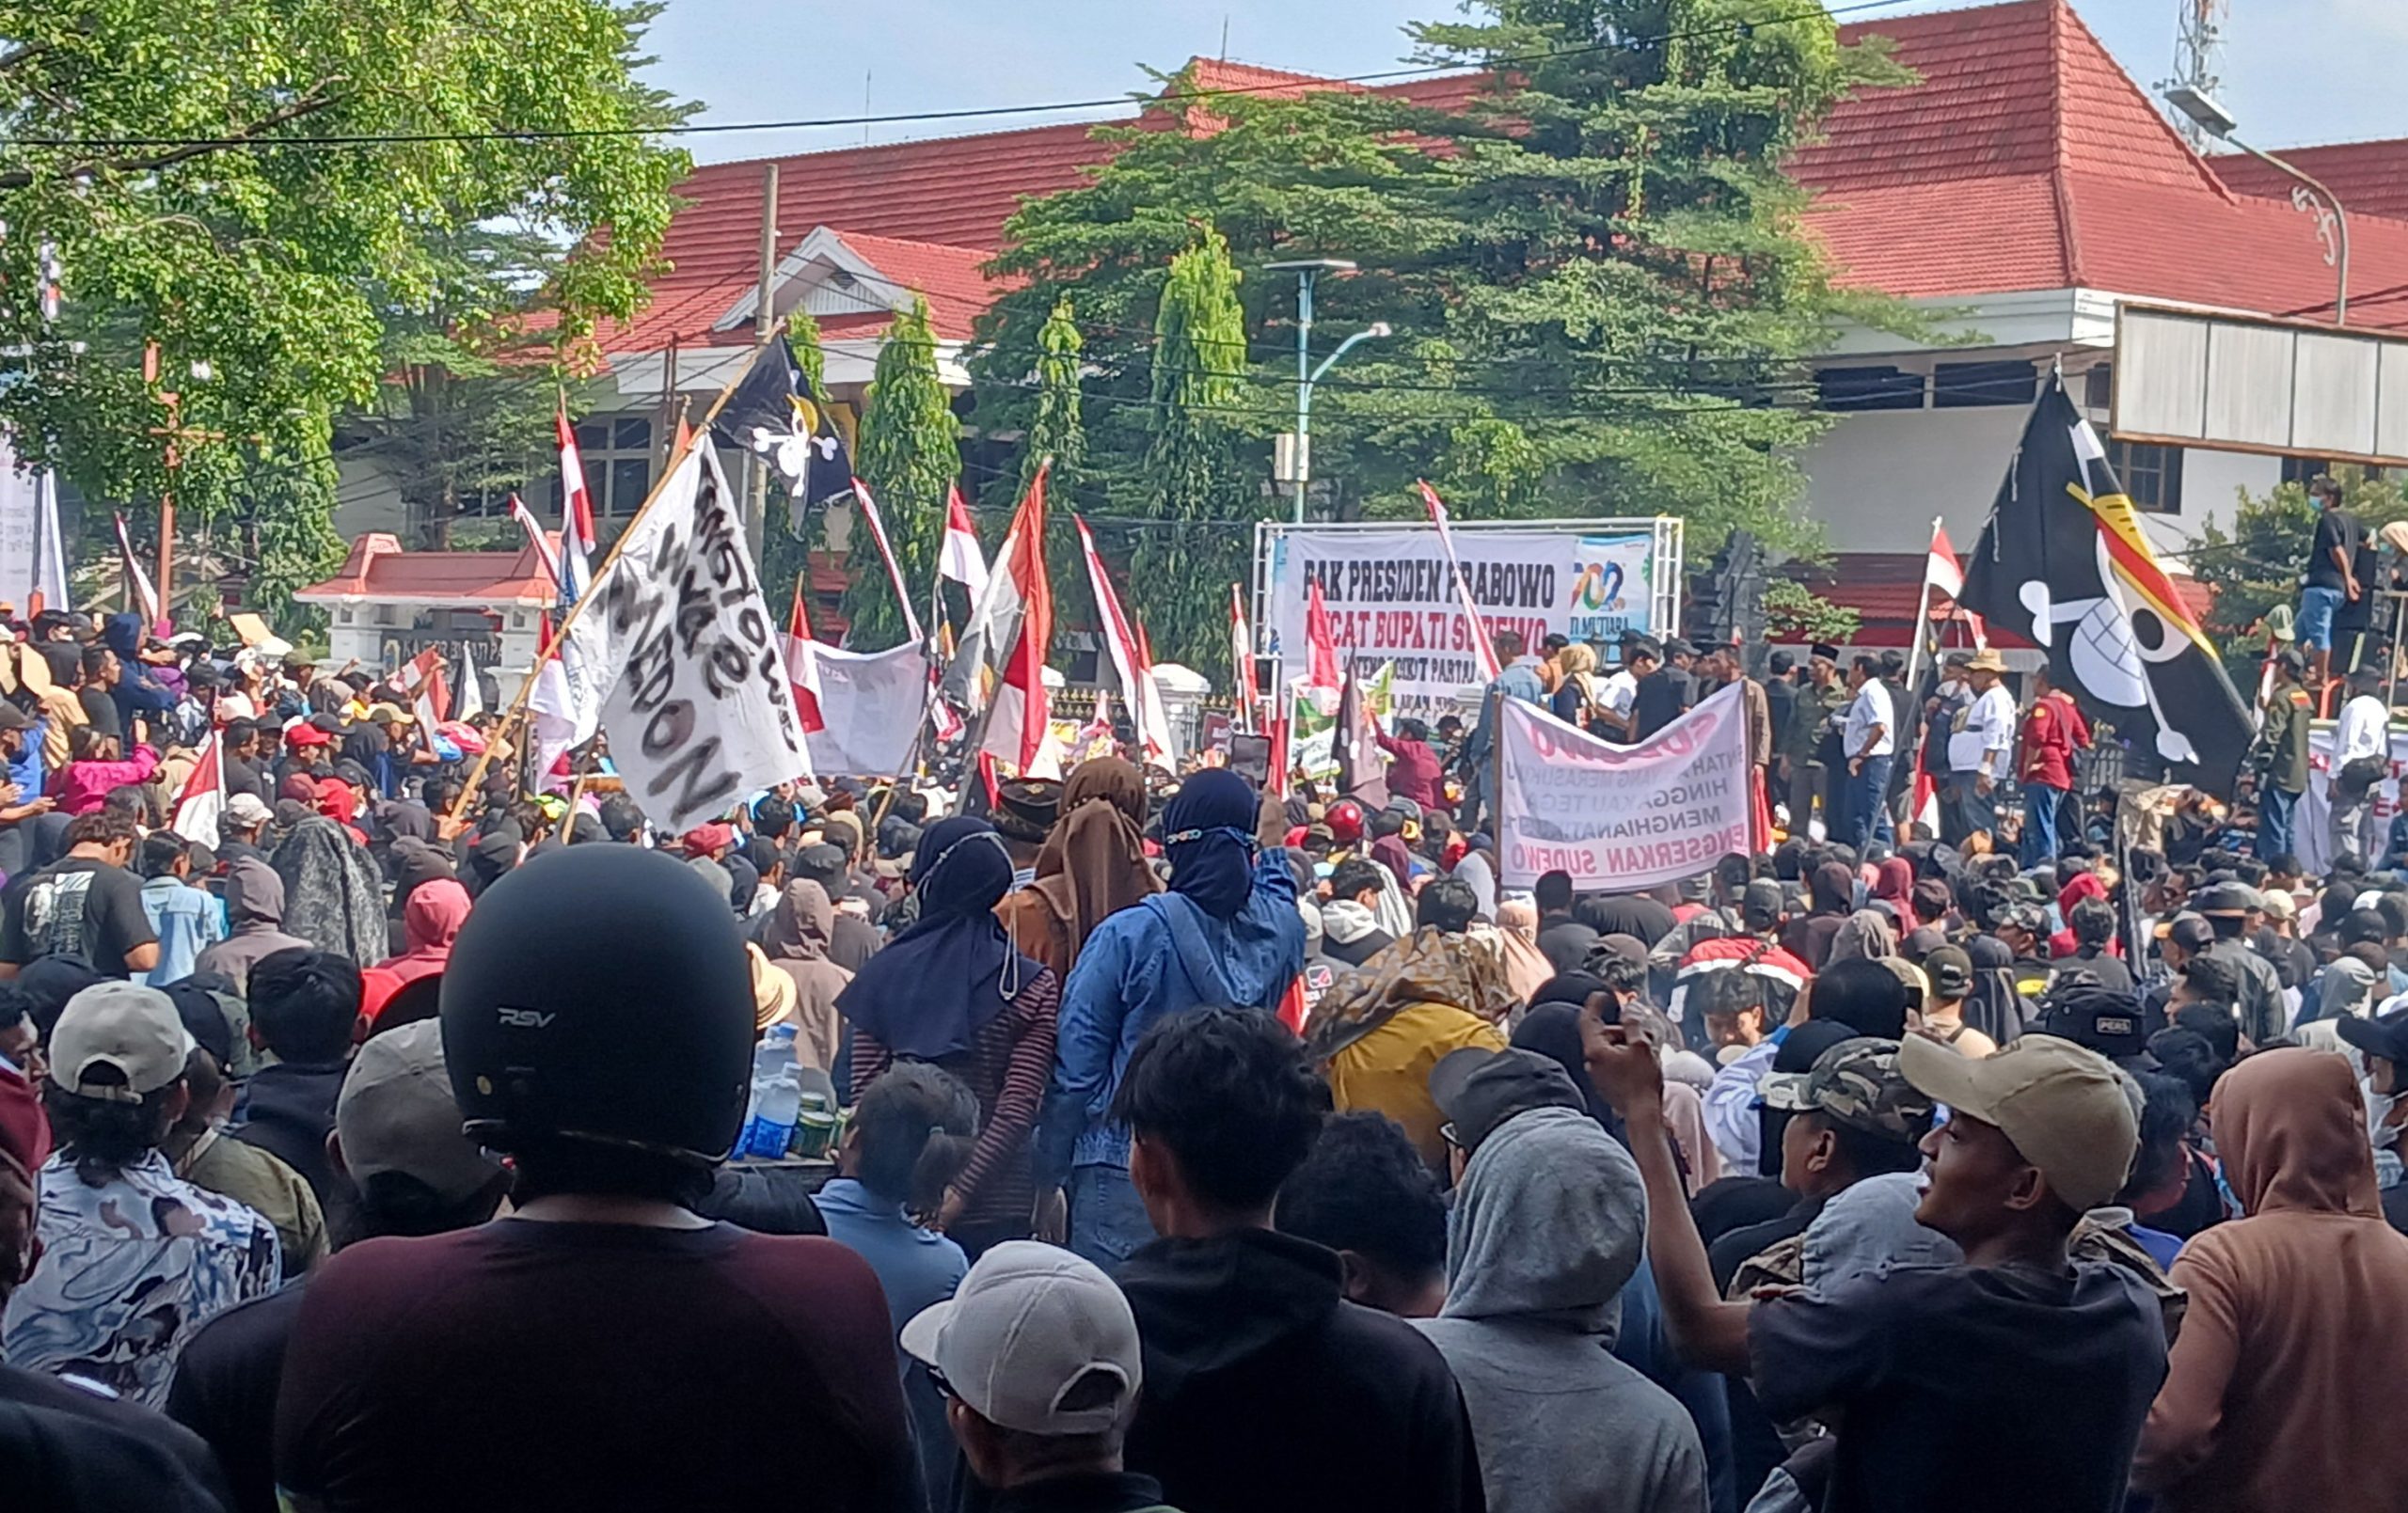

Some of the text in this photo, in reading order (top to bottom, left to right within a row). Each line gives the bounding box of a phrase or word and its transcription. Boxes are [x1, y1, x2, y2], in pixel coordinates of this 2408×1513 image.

[1303, 559, 1555, 609] PAK PRESIDEN PRABOWO
[1306, 610, 1370, 648] CAT
[1374, 610, 1447, 650] BUPATI
[497, 1007, 556, 1028] RSV
